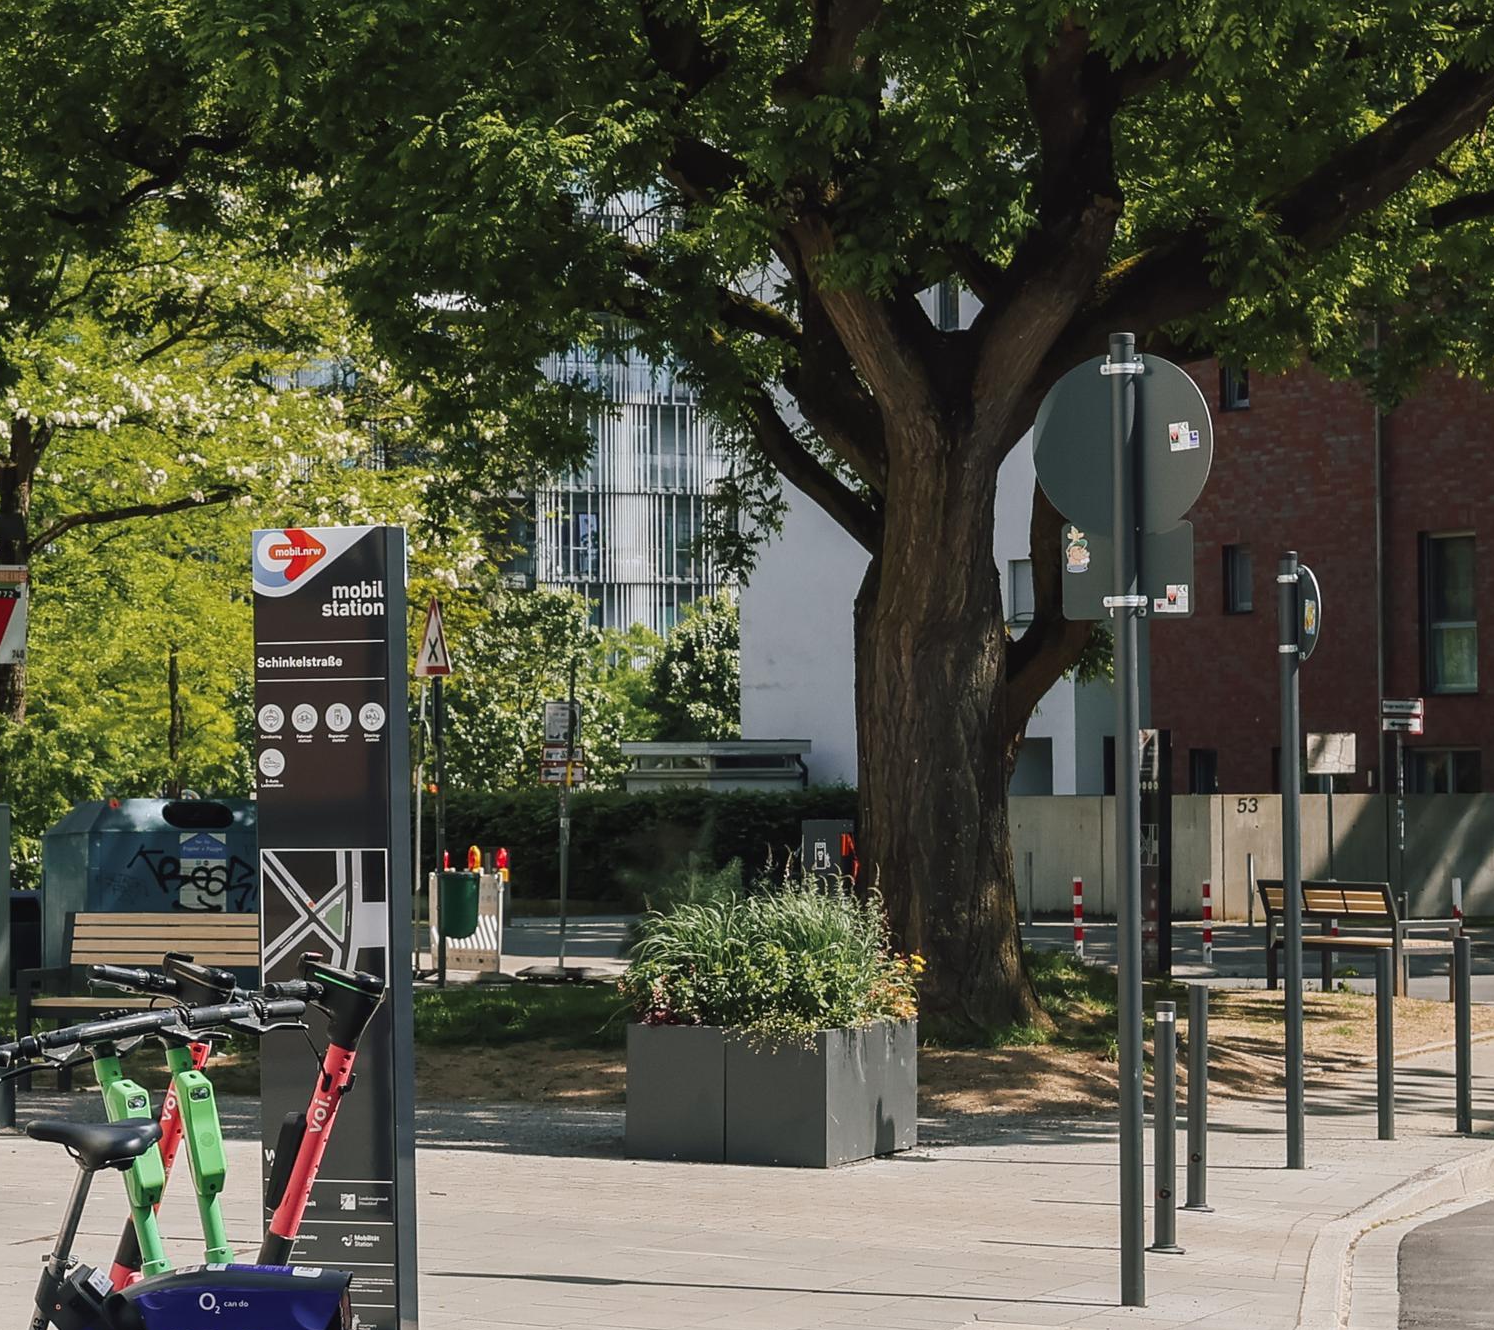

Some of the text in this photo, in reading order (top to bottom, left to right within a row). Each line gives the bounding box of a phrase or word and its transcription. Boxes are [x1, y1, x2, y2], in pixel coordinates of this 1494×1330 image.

[275, 547, 322, 557] mobil.nrw
[332, 580, 384, 599] mobil
[321, 599, 384, 617] station
[257, 655, 343, 669] Schinkelstraße
[1236, 797, 1258, 814] 53
[309, 1094, 332, 1134] voi.
[354, 1234, 380, 1242] Mobilität
[223, 1300, 238, 1308] can
[238, 1299, 249, 1308] do
